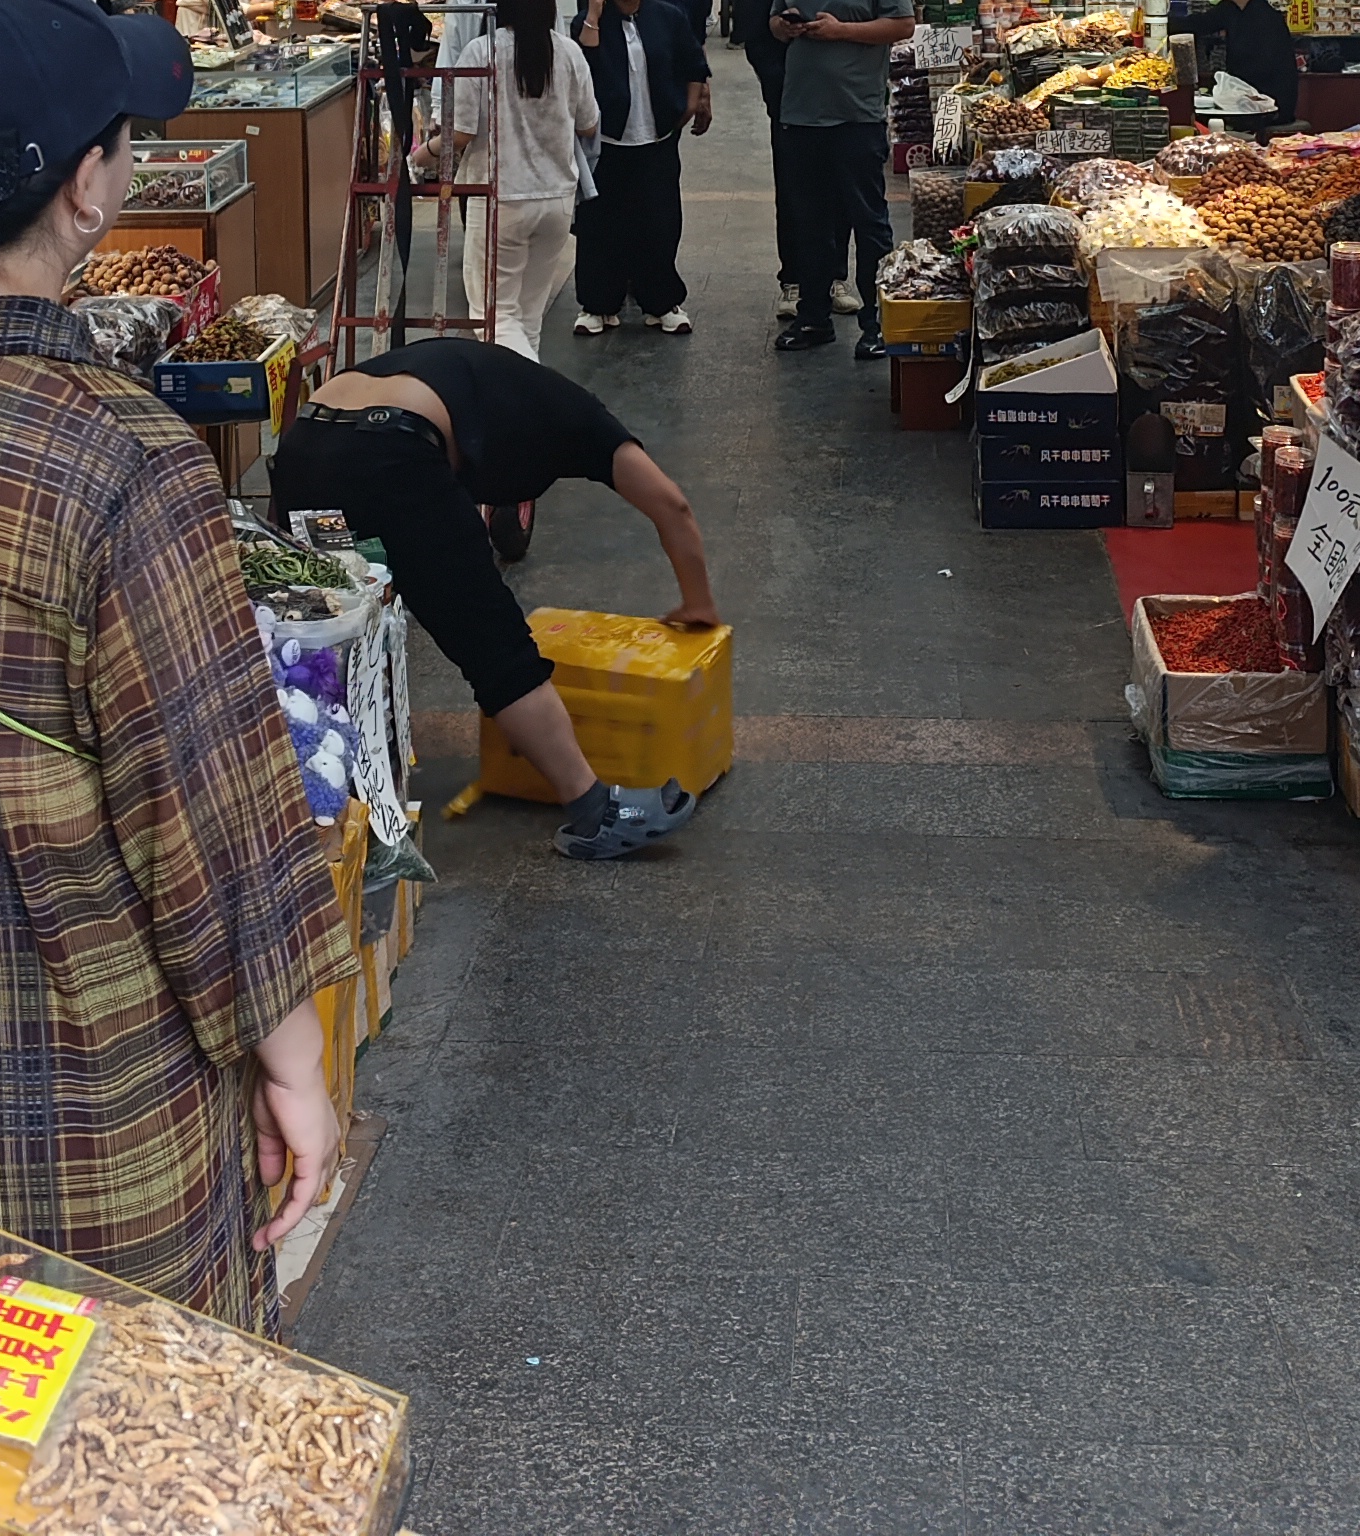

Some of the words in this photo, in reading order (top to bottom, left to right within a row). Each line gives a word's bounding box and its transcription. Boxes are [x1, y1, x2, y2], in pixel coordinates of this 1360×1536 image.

[1040, 450, 1111, 463] 风干串串葡萄干
[1040, 495, 1111, 508] 风干串串葡萄干
